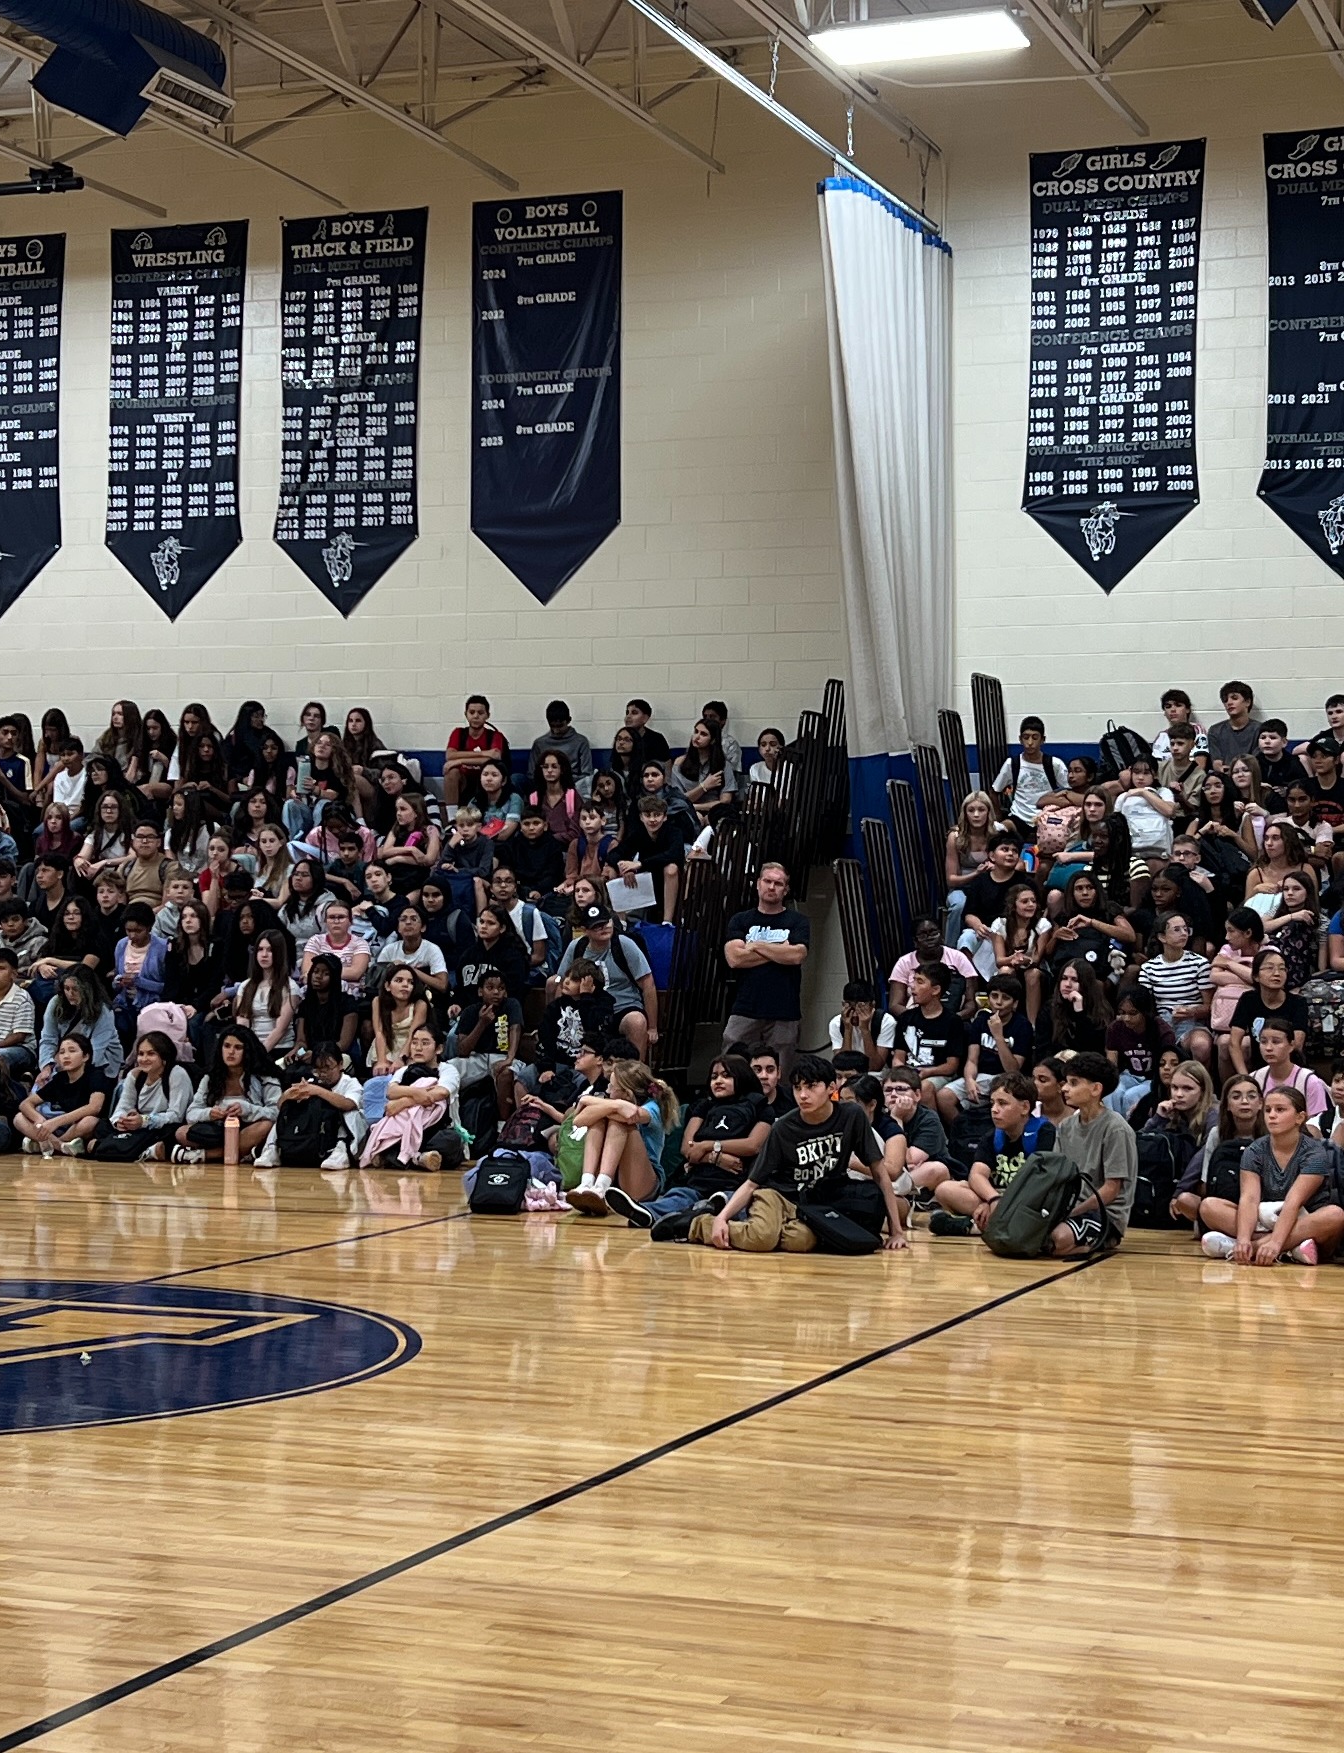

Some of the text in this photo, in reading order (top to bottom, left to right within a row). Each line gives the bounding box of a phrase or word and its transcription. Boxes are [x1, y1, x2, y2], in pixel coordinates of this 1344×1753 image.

[1086, 152, 1146, 170] GIRLS
[1268, 160, 1337, 178] CROSS
[1033, 169, 1200, 196] CROSS COUNTRY
[526, 203, 568, 218] BOYS
[332, 220, 374, 235] BOYS
[494, 221, 599, 240] VOLLEYBALL
[291, 238, 413, 258] TRACK & FIELD
[132, 249, 225, 267] WRESTLING
[536, 252, 575, 264] GRADE
[536, 292, 575, 303] GRADE
